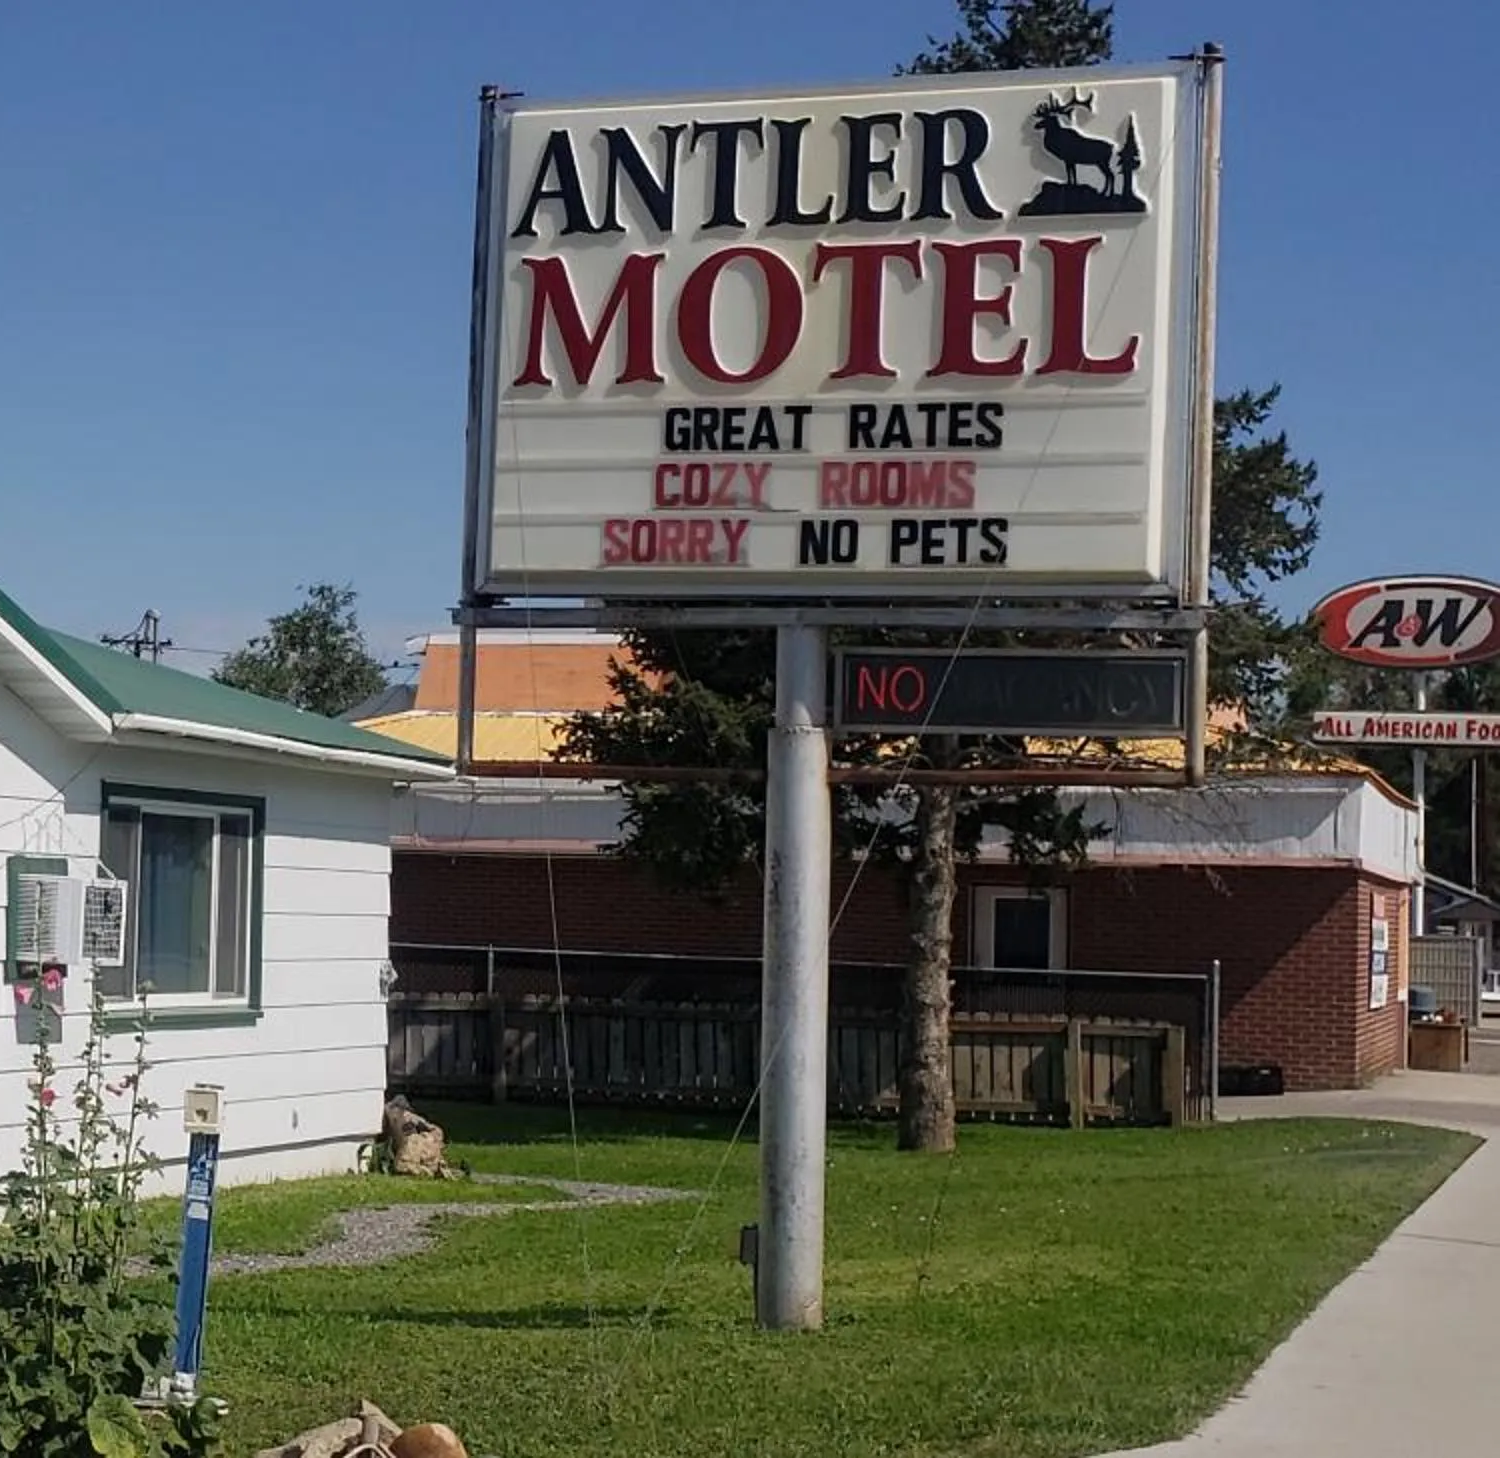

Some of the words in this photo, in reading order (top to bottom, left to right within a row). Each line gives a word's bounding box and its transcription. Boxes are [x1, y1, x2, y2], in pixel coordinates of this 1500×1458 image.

[510, 107, 1004, 238] ANTLER
[512, 237, 1140, 387] MOTEL
[664, 404, 813, 451] GREAT
[848, 402, 1005, 450] RATES
[653, 462, 773, 509] COZY
[820, 460, 977, 509] ROOMS
[603, 518, 751, 564] SORRY
[799, 518, 860, 565] NO
[889, 517, 1010, 565] PETS
[1347, 597, 1490, 648] A&W
[857, 665, 926, 712] NO
